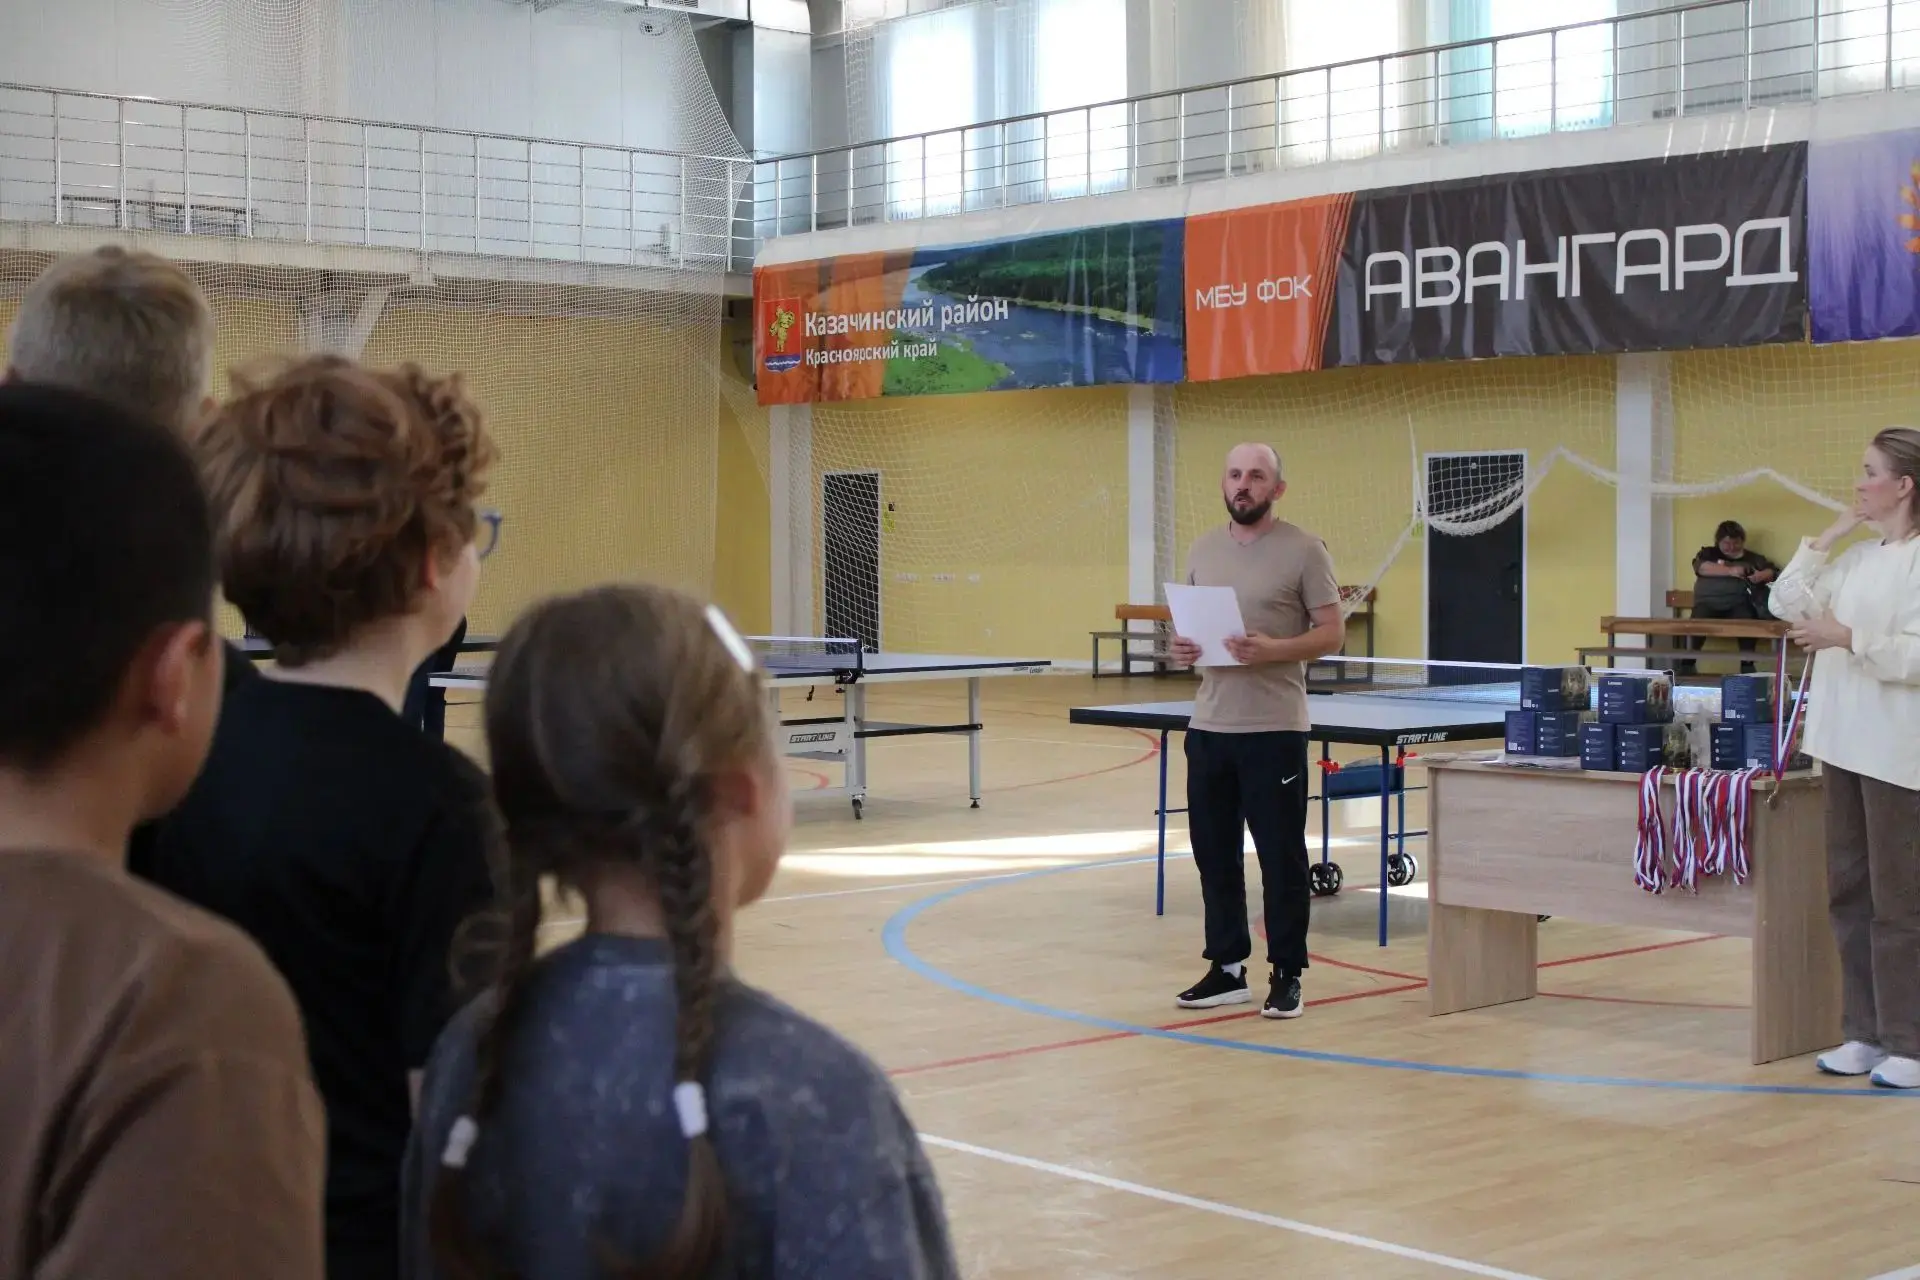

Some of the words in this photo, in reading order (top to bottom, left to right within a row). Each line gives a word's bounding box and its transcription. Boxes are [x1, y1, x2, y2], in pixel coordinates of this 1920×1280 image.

[1365, 216, 1798, 311] АВАНГАРД
[1196, 282, 1247, 311] МБУ
[1256, 274, 1312, 303] ФОК
[805, 299, 934, 337] Казачинский
[941, 294, 1009, 332] район
[806, 340, 899, 368] Красноярский
[903, 337, 937, 363] край
[790, 734, 818, 743] START
[818, 732, 834, 741] LINE
[1396, 734, 1427, 744] START
[1428, 731, 1447, 742] LINE
